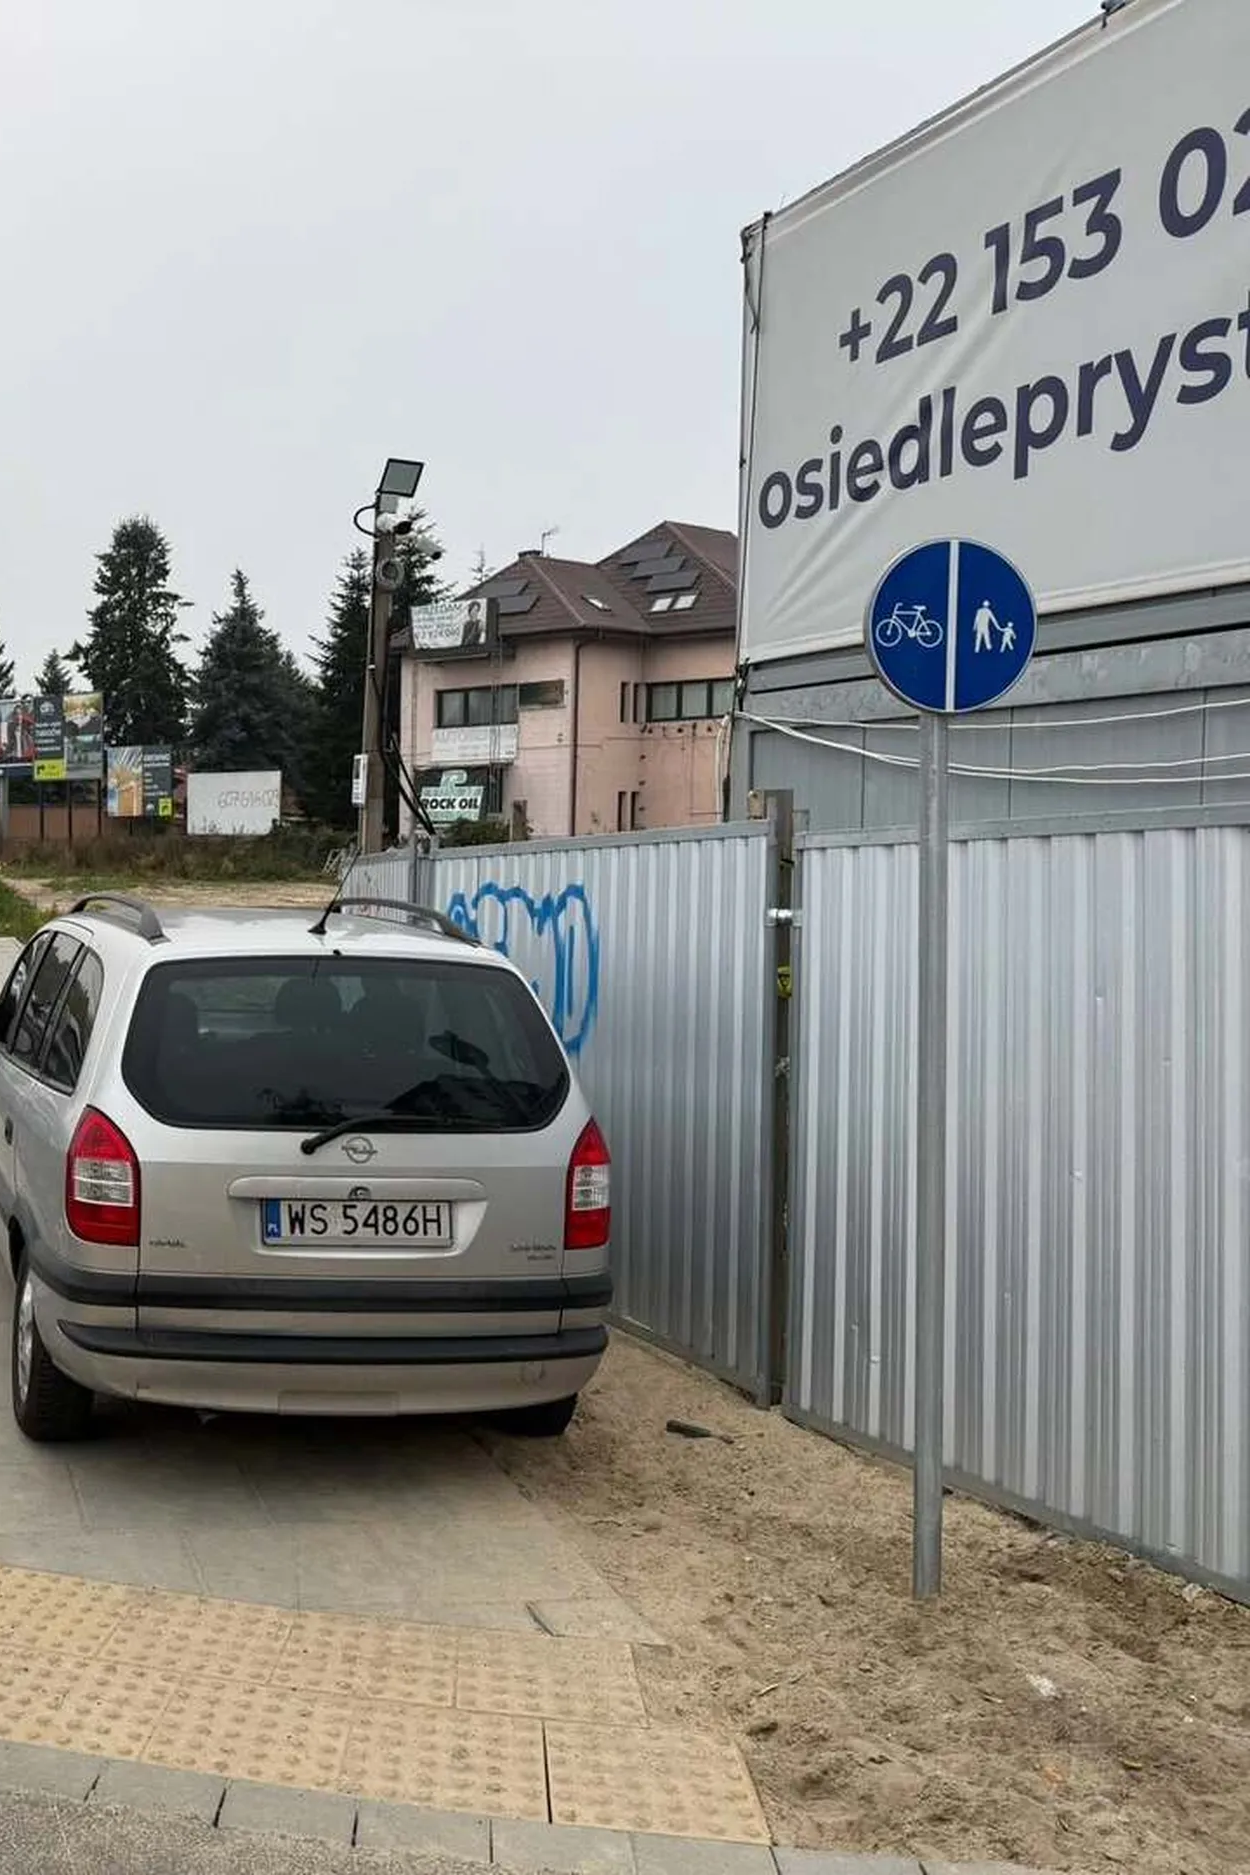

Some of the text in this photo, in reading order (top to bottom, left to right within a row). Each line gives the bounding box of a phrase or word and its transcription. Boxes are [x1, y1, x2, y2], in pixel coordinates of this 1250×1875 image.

[838, 252, 959, 364] +22
[983, 167, 1123, 316] 153
[459, 798, 480, 810] OIL
[287, 1203, 329, 1236] WS
[342, 1204, 442, 1237] 5486H
